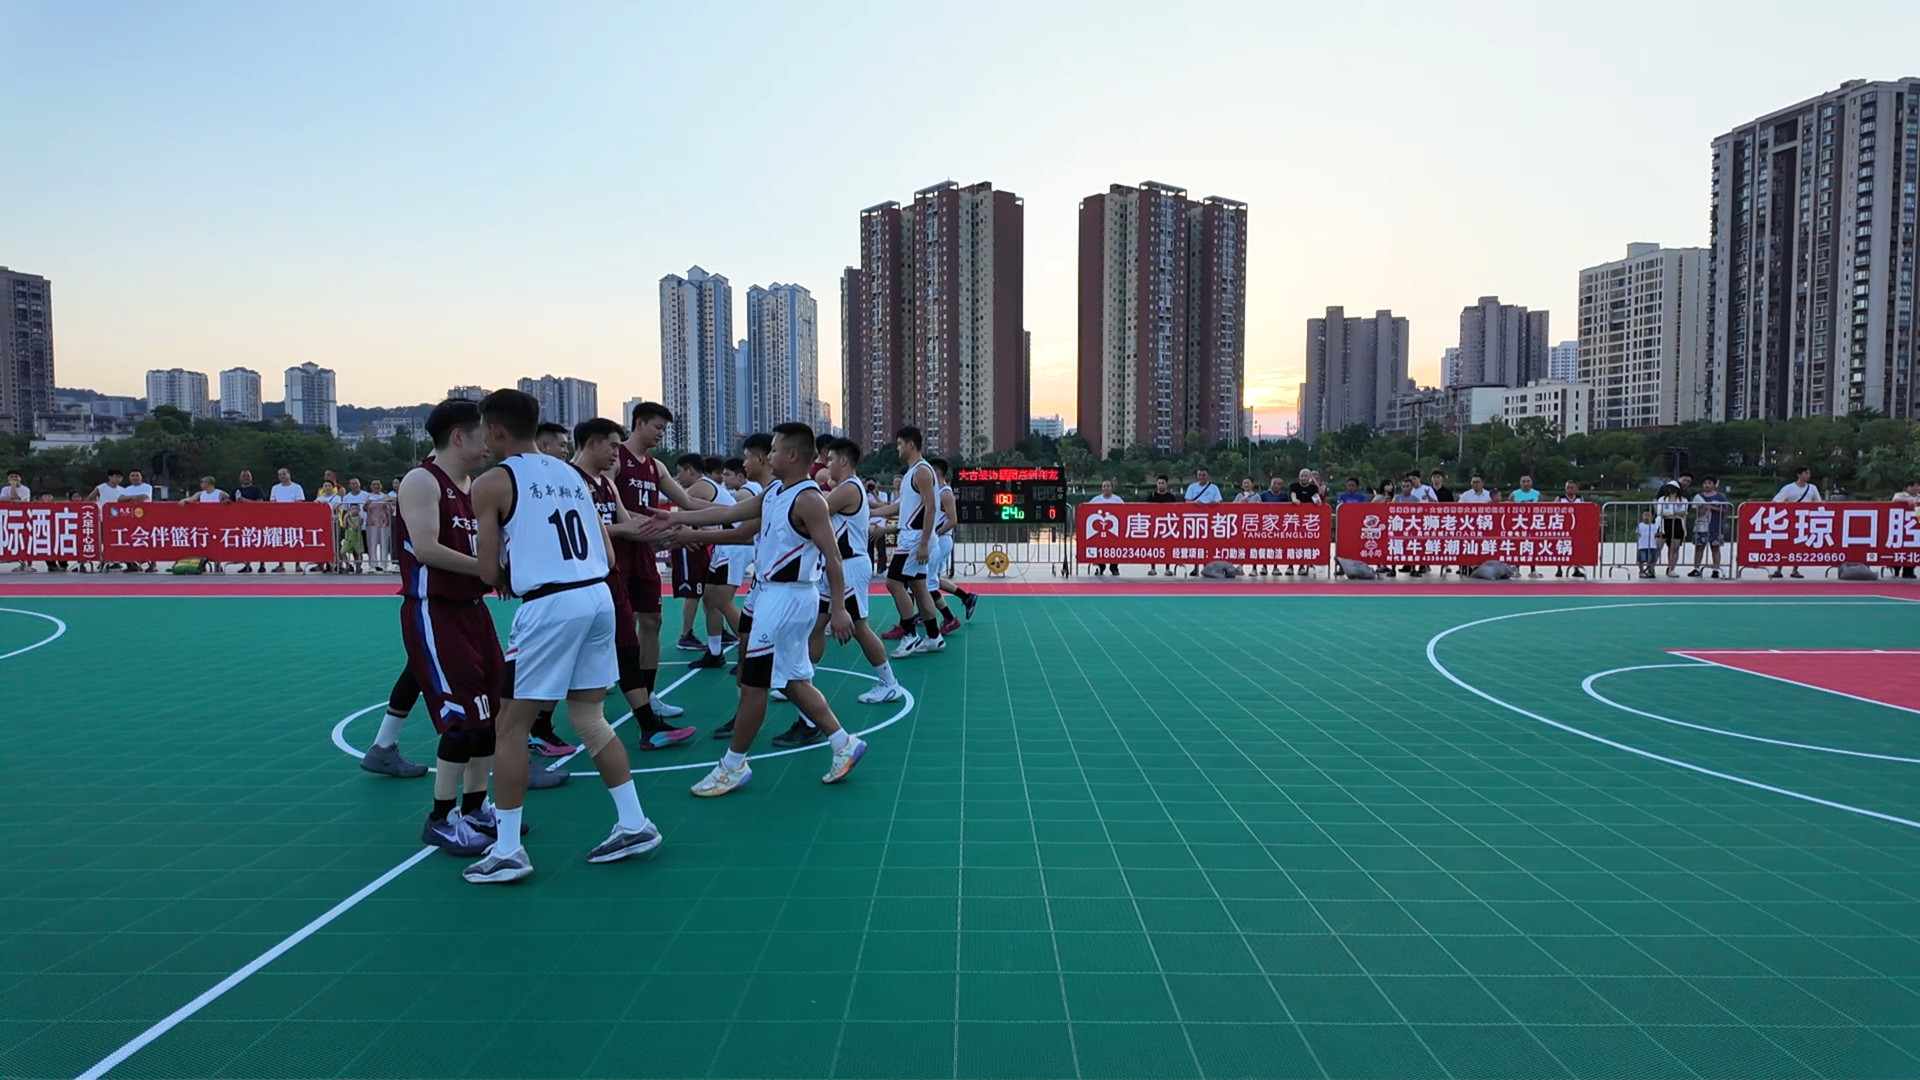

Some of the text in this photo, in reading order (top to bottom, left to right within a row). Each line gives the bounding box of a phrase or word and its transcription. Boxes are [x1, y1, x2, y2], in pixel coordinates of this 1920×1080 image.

[638, 489, 649, 507] 14
[0, 507, 79, 556] 际酒店
[547, 508, 589, 561] 10
[1125, 512, 1320, 539] 唐成丽都 居家养老
[1242, 531, 1320, 539] TANGCHENGLIDU
[1749, 506, 1920, 549] 华琼口腔
[110, 526, 326, 548] 工会伴篮行·石韵耀职工
[1098, 547, 1165, 559] 18802340405
[1388, 539, 1573, 556] 福牛鲜潮汕鲜牛肉火锅
[1759, 552, 1920, 563] 023-85229660 一环北
[696, 582, 703, 595] 8
[473, 694, 491, 720] 10
